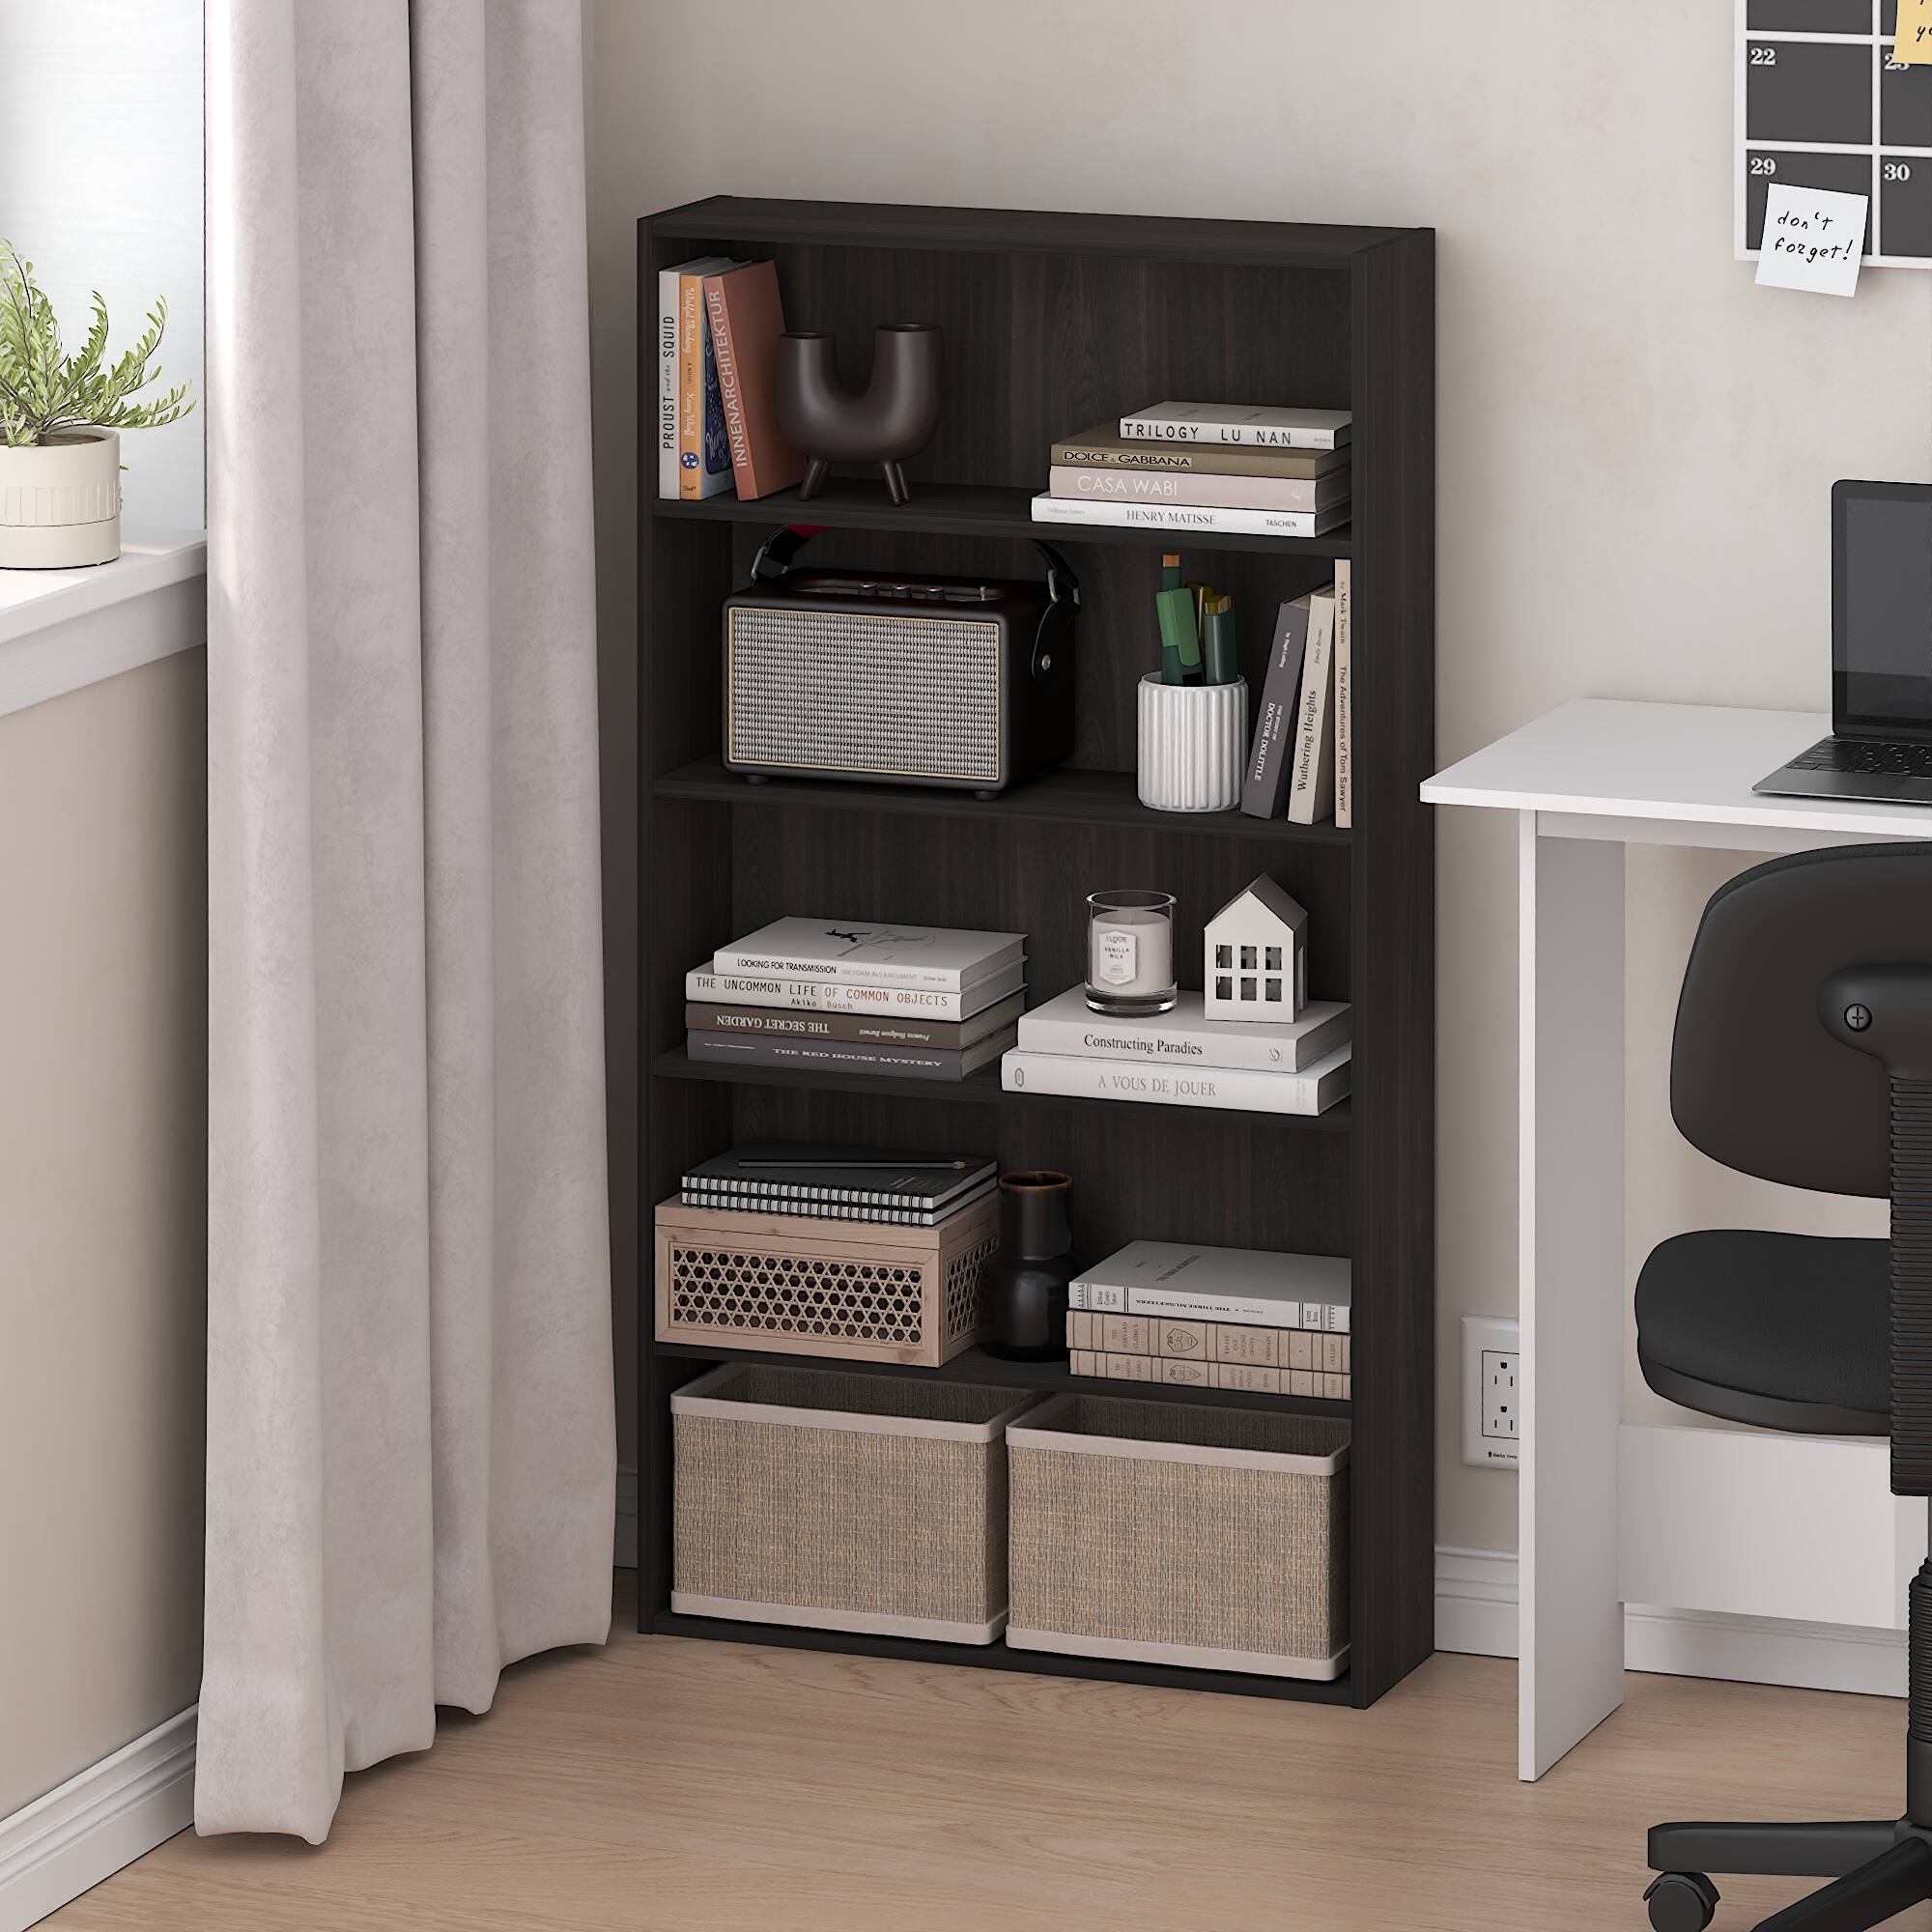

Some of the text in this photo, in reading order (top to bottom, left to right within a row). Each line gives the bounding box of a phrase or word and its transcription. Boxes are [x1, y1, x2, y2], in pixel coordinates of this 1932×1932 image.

[1749, 47, 1776, 66] 22
[1749, 157, 1776, 176] 29
[1884, 163, 1911, 182] 30
[1774, 238, 1854, 264] forget!
[662, 315, 675, 358] SQUID
[708, 289, 749, 469] INNENARCHITEKTUR
[662, 395, 675, 450] PROUST
[1124, 423, 1292, 444] TRILOGY LU NAN
[1064, 451, 1109, 462] DOLCE
[1118, 454, 1190, 467] GABBANA
[1077, 475, 1178, 497] CASA WABI
[1126, 509, 1217, 526] HENRY MATISSE
[1265, 519, 1297, 527] TASCHEN
[1339, 592, 1348, 615] Mark
[1339, 617, 1348, 645] Twain
[1254, 702, 1276, 781] DOCTOR DOLITTLE
[1296, 690, 1318, 791] Wuthering Heights
[1339, 667, 1348, 812] The Adventures of Tom Sawyer
[737, 958, 838, 974] LOOKING FOR TRANSMISSION
[696, 977, 949, 1007] THE UNCOMMON LIFE OF COMMON OBJECTS
[790, 998, 853, 1010] Akiko Busch
[716, 1014, 831, 1034] THE SECRET GARDEN
[1084, 1034, 1153, 1055] Constructing
[802, 1050, 829, 1059] RED
[832, 1053, 877, 1062] HOUSE
[879, 1056, 944, 1067] MYSTERY
[1097, 1075, 1217, 1097] A VOUS DE JOUER
